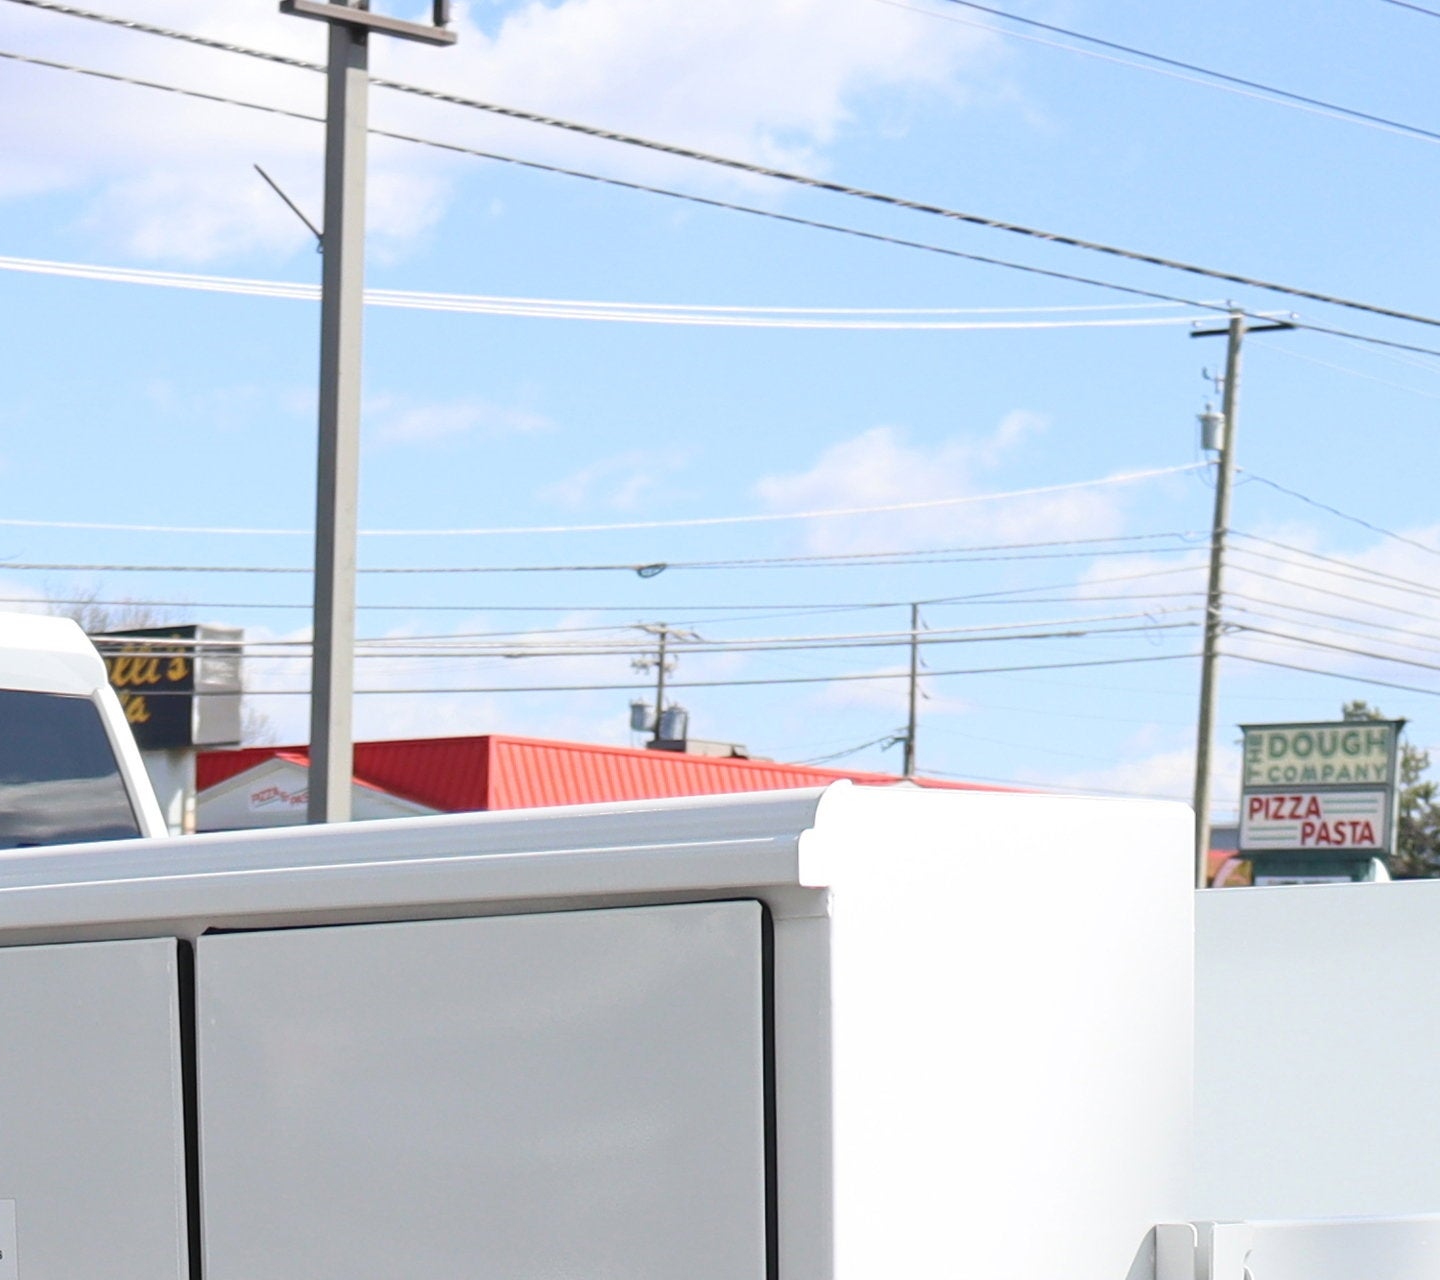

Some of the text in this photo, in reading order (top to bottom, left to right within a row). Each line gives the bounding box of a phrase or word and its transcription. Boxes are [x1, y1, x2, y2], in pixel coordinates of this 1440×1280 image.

[1248, 733, 1265, 781] THE
[1268, 731, 1388, 760] DOUGH
[1268, 762, 1386, 783] COMPANY
[1248, 796, 1321, 821] PIZZA
[1301, 821, 1375, 846] PASTA
